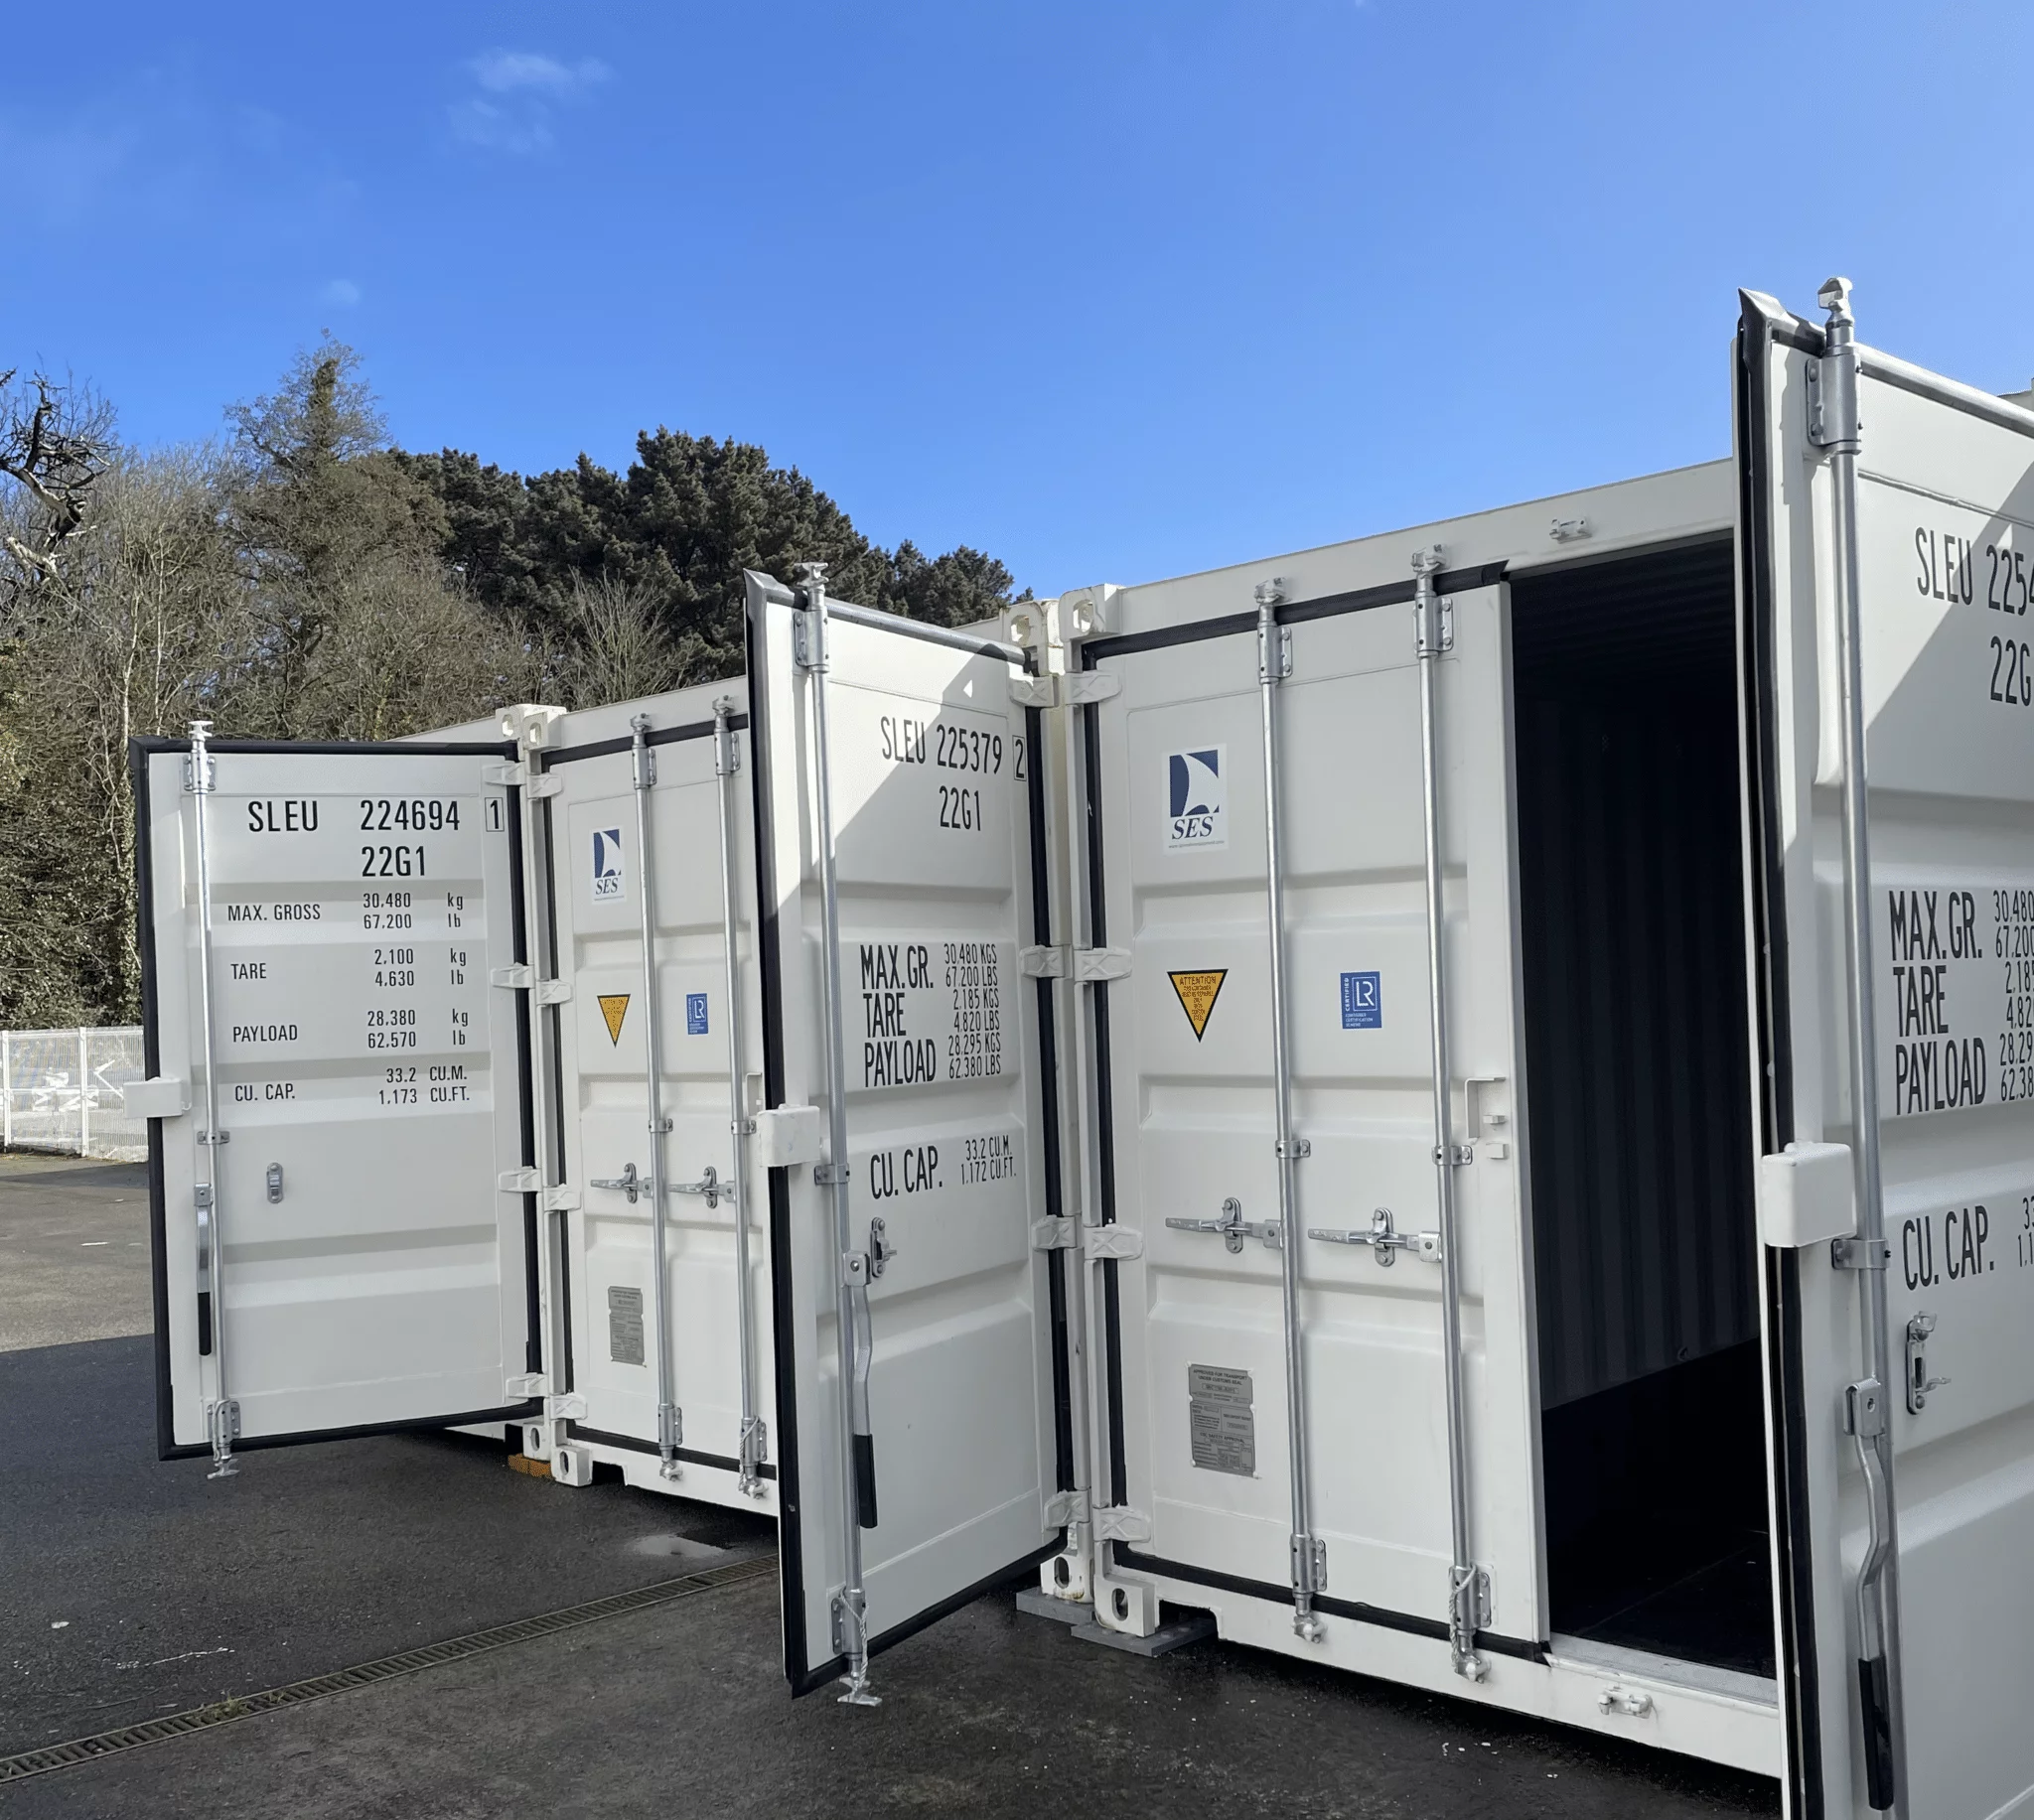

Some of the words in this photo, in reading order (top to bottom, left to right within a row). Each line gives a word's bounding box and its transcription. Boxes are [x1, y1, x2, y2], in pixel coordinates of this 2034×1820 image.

[1915, 526, 1973, 606] SLEU
[1990, 635, 2031, 706] 22G
[881, 717, 926, 764] SLEU
[937, 724, 1002, 774] 225379
[1015, 739, 1025, 778] 2
[248, 800, 319, 832] SLEU
[361, 800, 460, 831] 224694
[490, 800, 500, 829] 1
[940, 785, 981, 831] 22G1
[1172, 816, 1214, 840] SES
[362, 846, 425, 877] 22G1
[596, 878, 619, 895] SES
[227, 905, 267, 921] MAX.
[274, 904, 321, 920] GROSS
[363, 893, 412, 909] 30,480
[447, 893, 464, 910] kg
[363, 913, 412, 929] 67,200
[448, 913, 461, 928] lb
[374, 948, 414, 965] 2,100
[450, 948, 467, 966] kg
[980, 942, 997, 964] KGS
[230, 963, 267, 980] TARE
[375, 971, 415, 987] 4,630
[451, 970, 464, 985] lb
[981, 965, 998, 987] LBS
[2005, 960, 2034, 993] 2,18
[983, 988, 1000, 1009] KGS
[1892, 965, 1950, 1038] TARE
[367, 1009, 416, 1027] 28,380
[452, 1009, 469, 1027] kg
[863, 992, 907, 1038] TARE
[984, 1010, 1000, 1031] LBS
[2006, 996, 2034, 1029] 4,82
[233, 1025, 298, 1043] PAYLOAD
[368, 1031, 416, 1049] 62,570
[453, 1031, 466, 1046] lb
[985, 1033, 1001, 1053] KGS
[385, 1067, 417, 1083] 33.2
[429, 1065, 468, 1081] CU.M.
[864, 1039, 937, 1087] PAYLOAD
[985, 1054, 1001, 1075] LBS
[1895, 1038, 1986, 1116] PAYLOAD
[234, 1085, 258, 1102] CU.
[265, 1083, 296, 1100] CAP.
[378, 1088, 417, 1105] 1,173
[430, 1086, 470, 1103] CU.FT.
[965, 1138, 986, 1161] 33.2
[989, 1134, 1012, 1158] CU.M.
[870, 1152, 899, 1199] CU.
[904, 1146, 943, 1193] CAP.
[990, 1157, 1017, 1181] CU.FT.
[1903, 1216, 1940, 1292] CU.
[1945, 1204, 1994, 1280] CAP.
